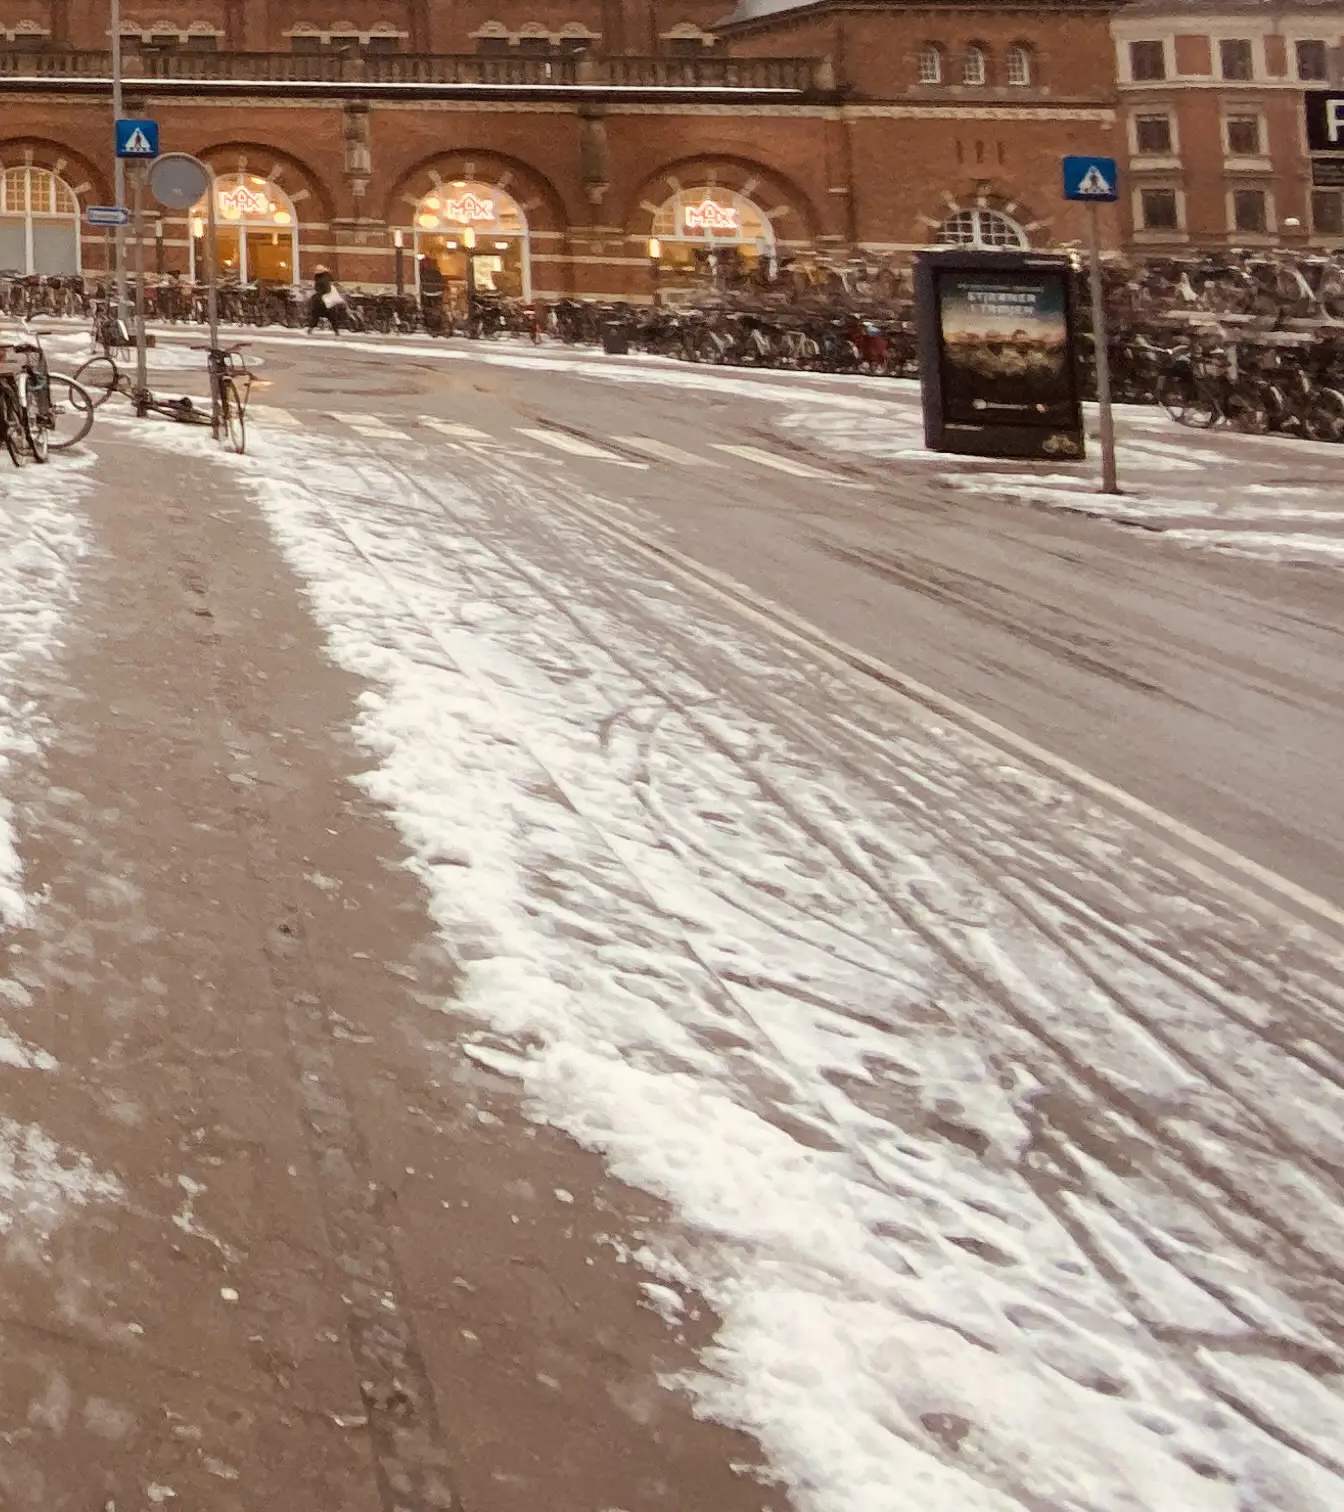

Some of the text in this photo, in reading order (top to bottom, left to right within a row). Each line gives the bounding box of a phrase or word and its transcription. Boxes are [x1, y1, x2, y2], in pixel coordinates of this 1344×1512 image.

[218, 185, 269, 214] MAX
[447, 192, 495, 220] MAX
[684, 199, 738, 228] MAX
